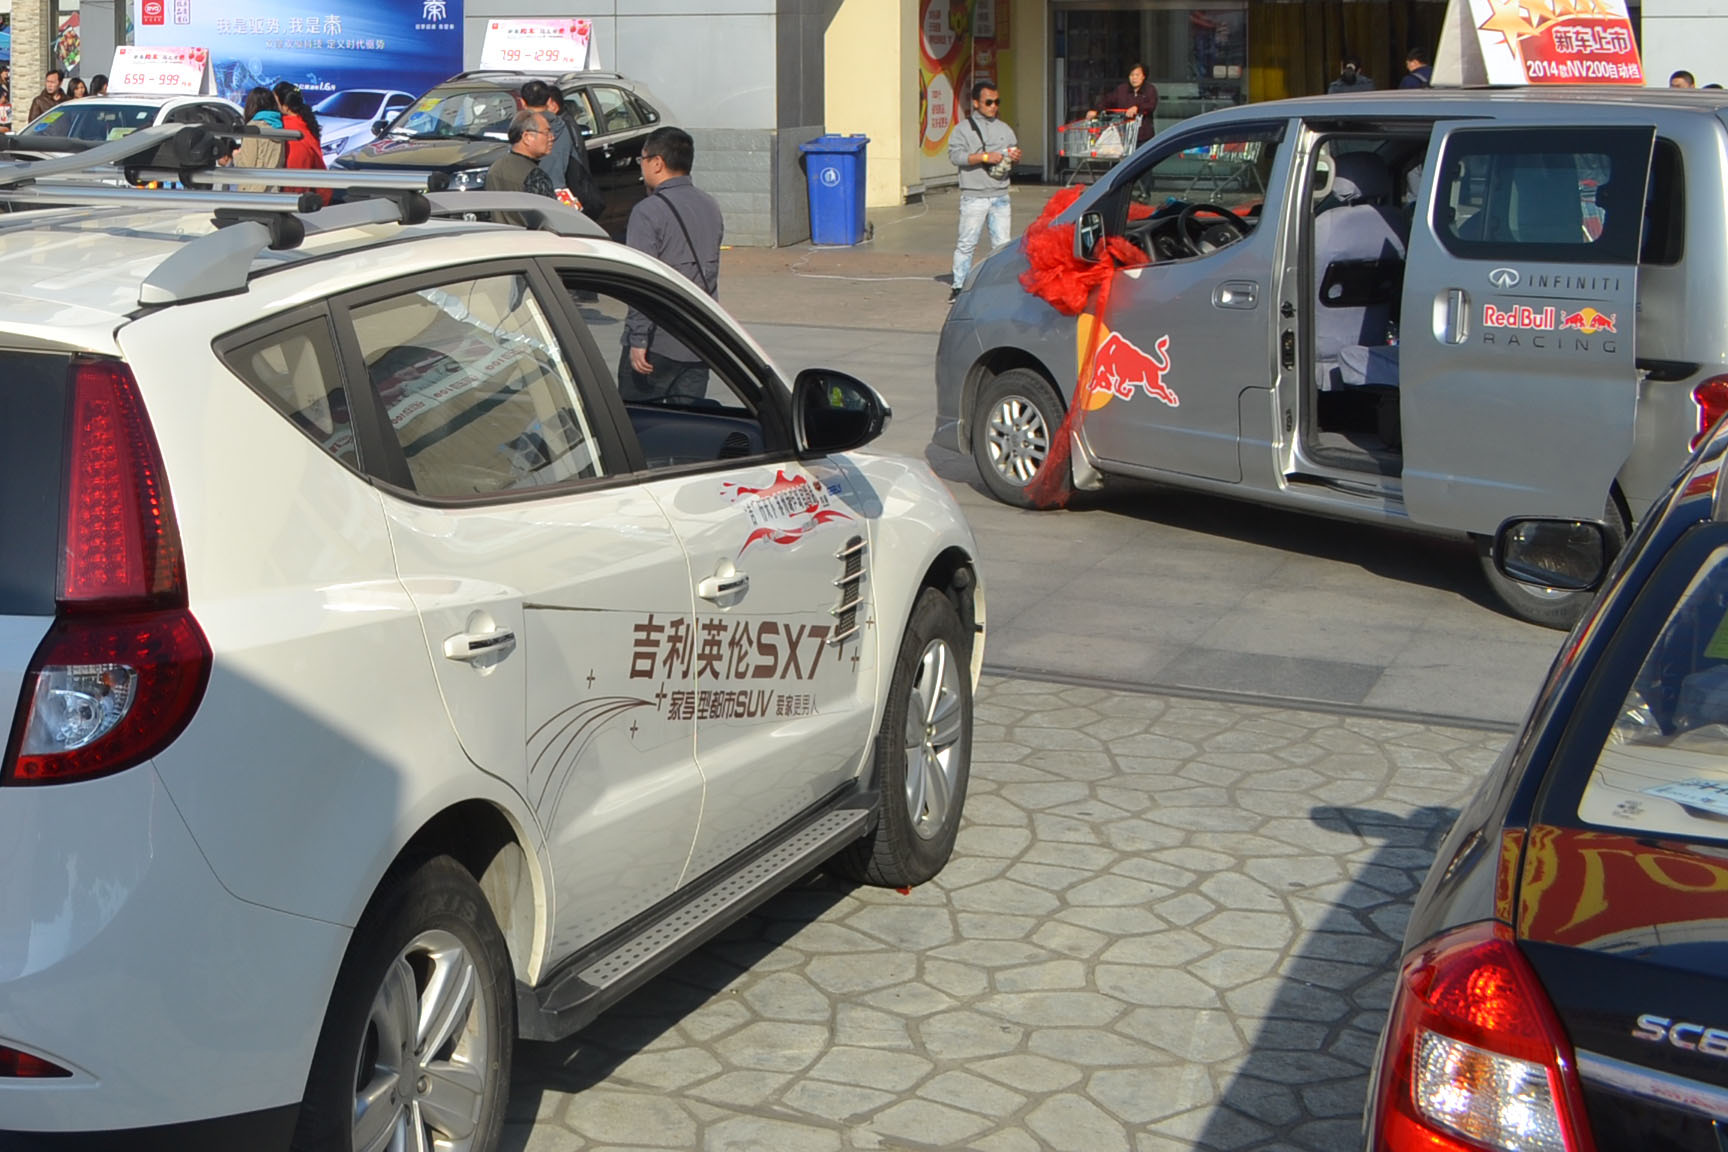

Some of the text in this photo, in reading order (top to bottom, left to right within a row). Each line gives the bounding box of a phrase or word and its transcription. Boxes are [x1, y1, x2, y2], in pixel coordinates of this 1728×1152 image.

[1552, 25, 1631, 54] 新车上市
[1528, 274, 1621, 291] INFINITI
[1483, 332, 1617, 354] RACING
[629, 613, 831, 681] 吉利英伦SX7
